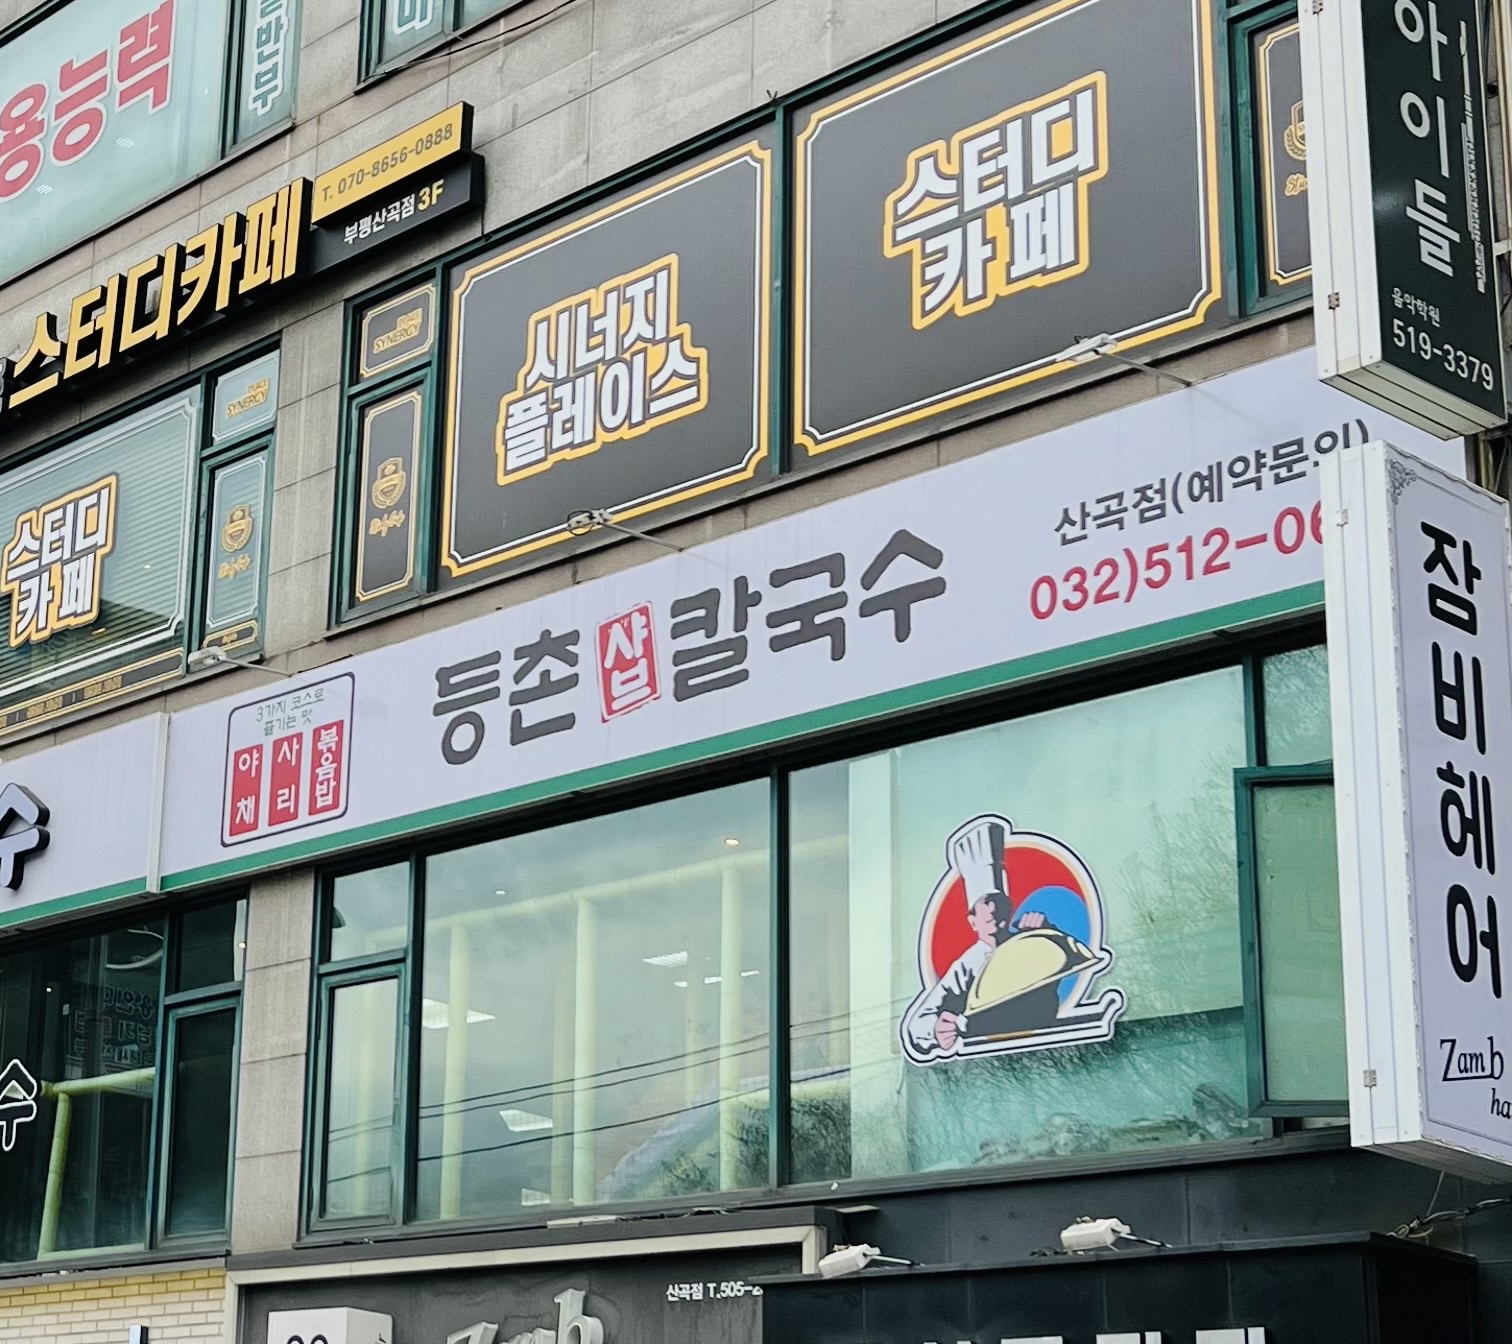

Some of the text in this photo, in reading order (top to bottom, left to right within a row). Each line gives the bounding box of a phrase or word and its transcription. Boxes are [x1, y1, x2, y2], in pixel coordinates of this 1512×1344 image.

[337, 122, 455, 196] 070-8656-0888
[892, 87, 1097, 243] 스터디
[344, 178, 445, 245] 부평산곡점 3F
[920, 185, 1079, 313] 카페
[9, 178, 310, 410] 스터디카페
[524, 269, 672, 387] 시너지
[1392, 286, 1442, 330] 음악학원
[1393, 319, 1494, 394] 519-3379
[501, 340, 702, 473] 플레이스
[7, 484, 112, 580] 스터디
[16, 563, 97, 644] 카페
[433, 630, 580, 766] 등촌
[670, 529, 947, 704] 칼국수
[256, 687, 325, 723] 3가지 코스로
[263, 708, 313, 737] 즐기는 맛
[235, 748, 260, 825] 야채
[276, 737, 299, 814] 사리
[316, 725, 339, 809] 볶음밥
[1420, 520, 1503, 1001] 잠비헤어
[1438, 1035, 1505, 1082] Zamb
[666, 1283, 704, 1302] 산곡점
